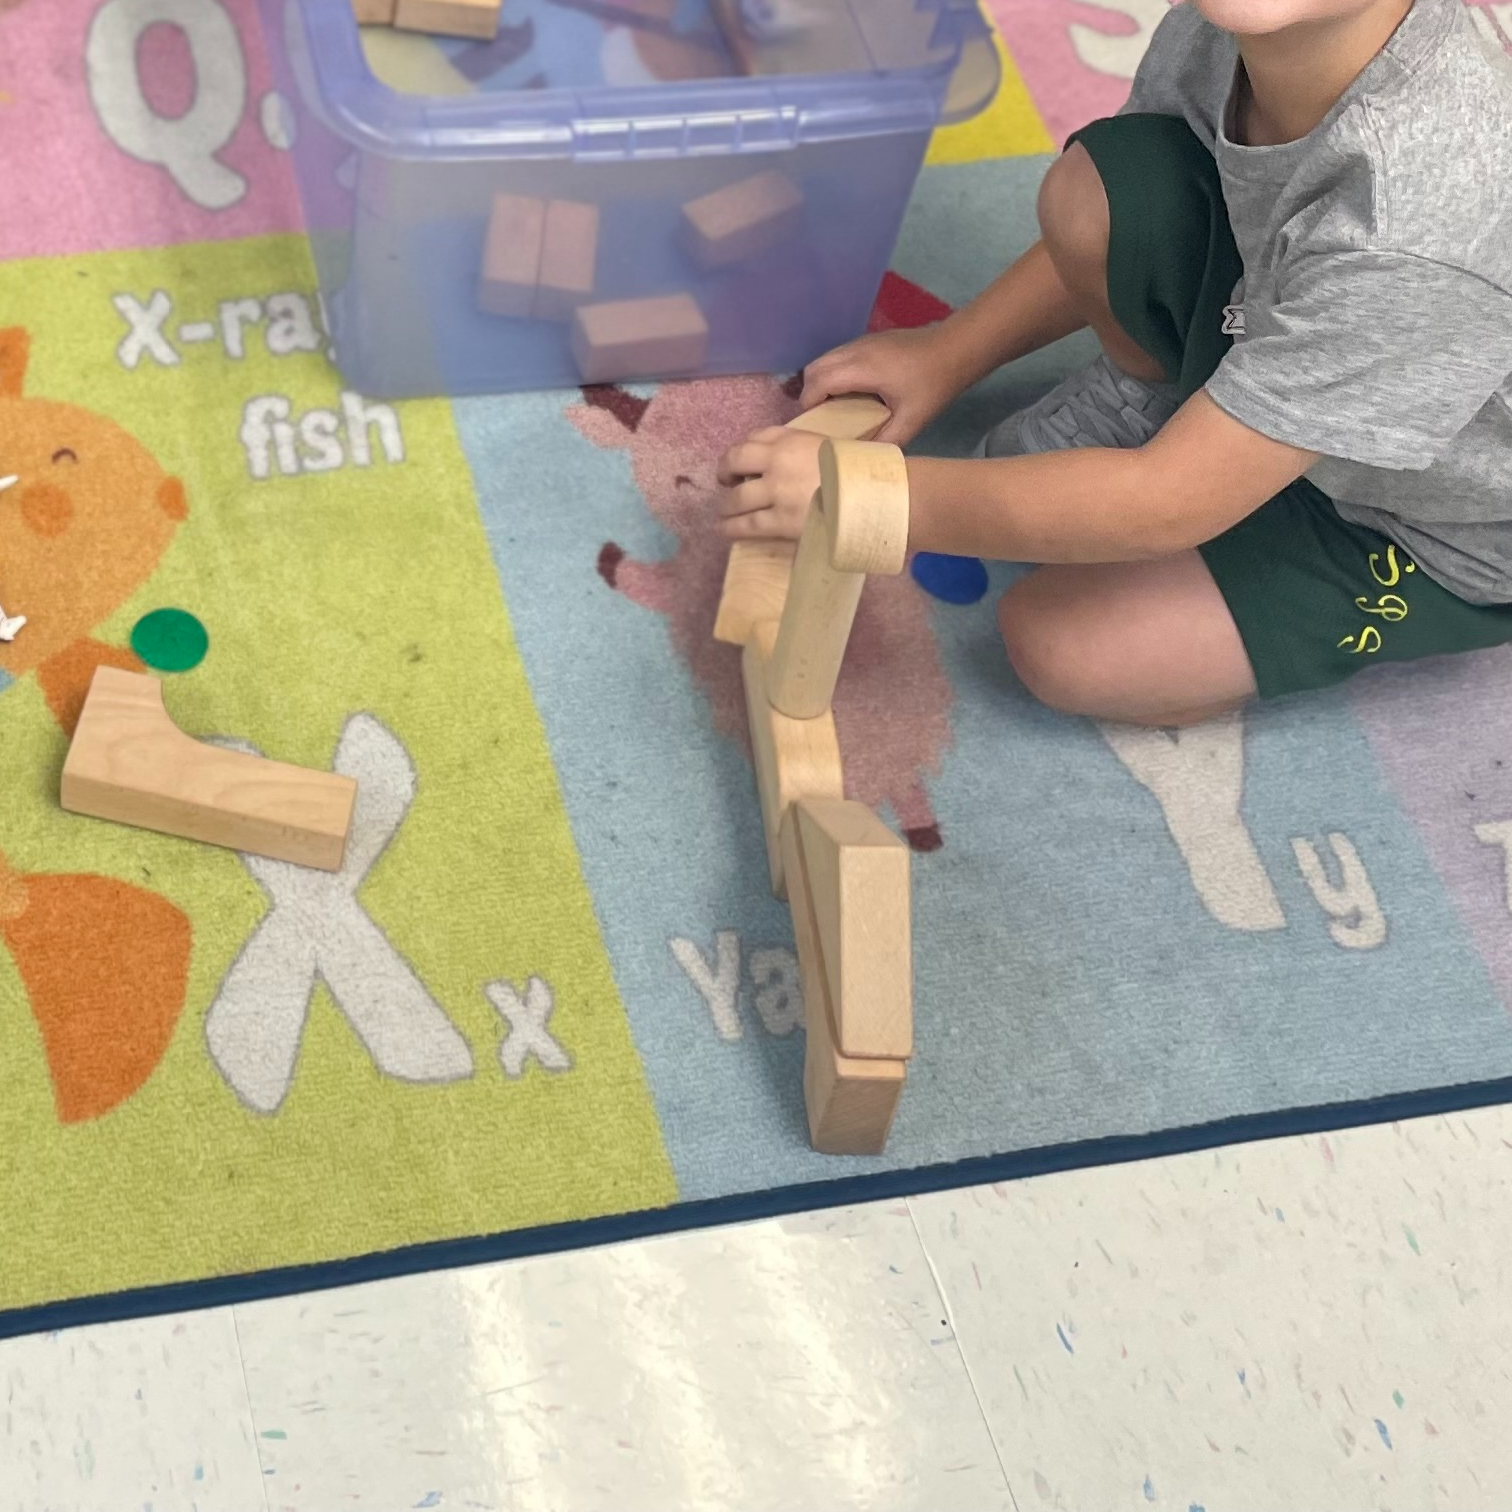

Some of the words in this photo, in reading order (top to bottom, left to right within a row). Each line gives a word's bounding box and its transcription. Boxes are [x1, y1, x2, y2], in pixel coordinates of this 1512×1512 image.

[241, 390, 406, 479] fish
[204, 713, 476, 1116] X
[484, 974, 573, 1079] x
[1292, 830, 1388, 950] y
[670, 929, 807, 1041] Ya
